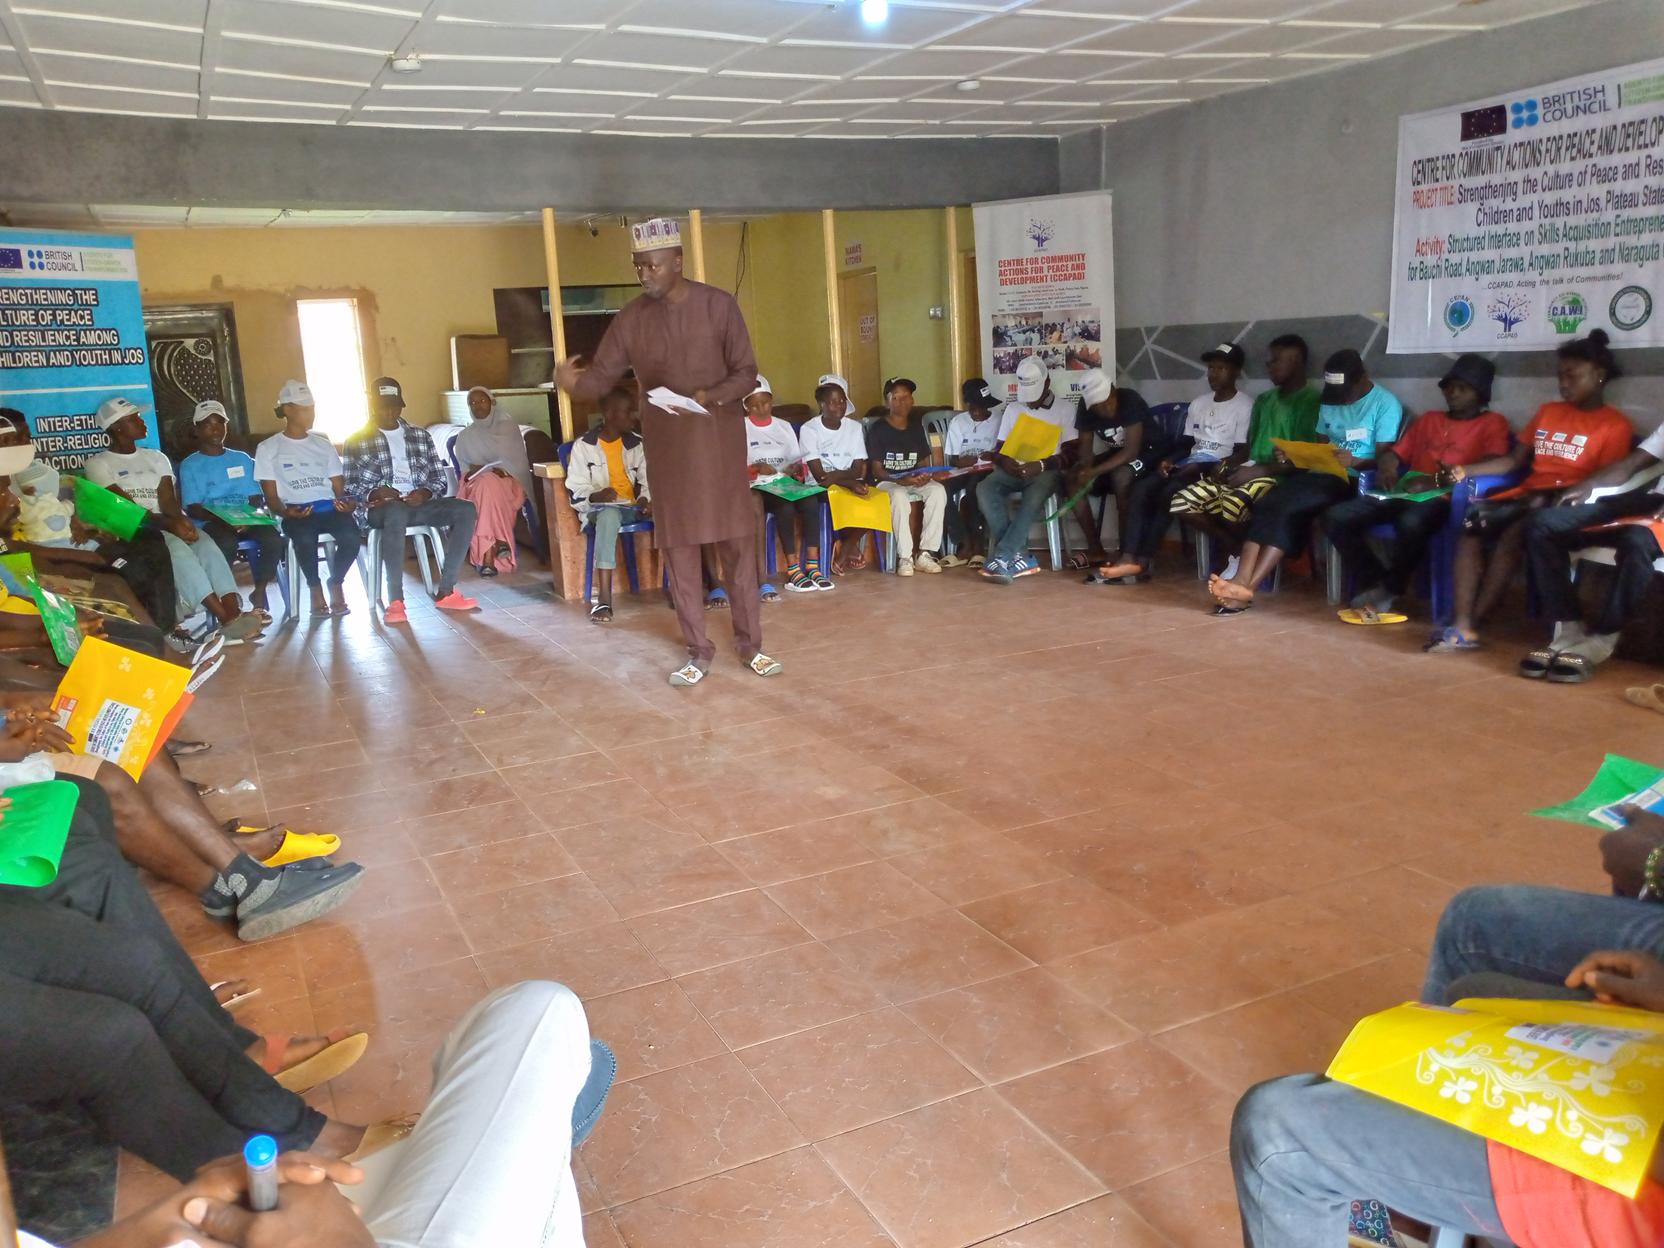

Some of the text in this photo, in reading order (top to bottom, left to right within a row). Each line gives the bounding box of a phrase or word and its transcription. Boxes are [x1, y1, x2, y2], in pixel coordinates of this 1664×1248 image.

[1542, 84, 1606, 110] BRITISH
[1543, 99, 1611, 123] COUNCIL
[1412, 115, 1664, 187] CENTRE FOR COMMUNITY ACTIONS FOR PEACE AND DEVELOP
[1412, 188, 1438, 209] PROJECT
[1522, 174, 1538, 196] the
[1540, 167, 1574, 193] Culture
[1576, 164, 1589, 188] of
[1589, 163, 1618, 186] Peace
[1621, 156, 1640, 181] and
[1644, 154, 1664, 177] Res
[1475, 206, 1514, 227] Children
[1515, 201, 1534, 223] and
[1537, 197, 1571, 220] Youths
[1572, 195, 1583, 216] in
[1605, 190, 1639, 212] Plateau
[1447, 230, 1487, 255] Structured
[1487, 228, 1521, 250] Interface
[1524, 229, 1535, 247] on
[1538, 222, 1560, 246] Skills
[1561, 217, 1612, 249] Acquisition
[44, 250, 73, 260] BRITISH
[998, 253, 1086, 268] CENTRE FOR COMMUNITY
[1408, 261, 1418, 281] for
[1419, 260, 1442, 281] Bauchi
[1464, 256, 1495, 281] Angwan
[1527, 251, 1560, 276] Angwan
[1563, 245, 1595, 269] Rukuba
[1599, 242, 1616, 265] and
[1617, 241, 1660, 268] Naraguta
[46, 261, 79, 272] COUNCIL
[998, 263, 1086, 277] ACTIONS FOR PEACE AND
[1000, 275, 1048, 287] DEVELOPMENT
[1516, 280, 1536, 288] Acting
[1567, 276, 1575, 284] of
[0, 289, 98, 305] ENGTHENING THE
[38, 310, 53, 325] OF
[55, 310, 93, 325] PEACE
[13, 331, 78, 346] RESILIENCE
[80, 330, 119, 345] AMONG
[49, 350, 72, 367] AND
[72, 350, 110, 366] YOUTH
[110, 350, 122, 364] IN
[123, 349, 144, 364] JOS
[32, 433, 110, 452] NTER-RELIGIO
